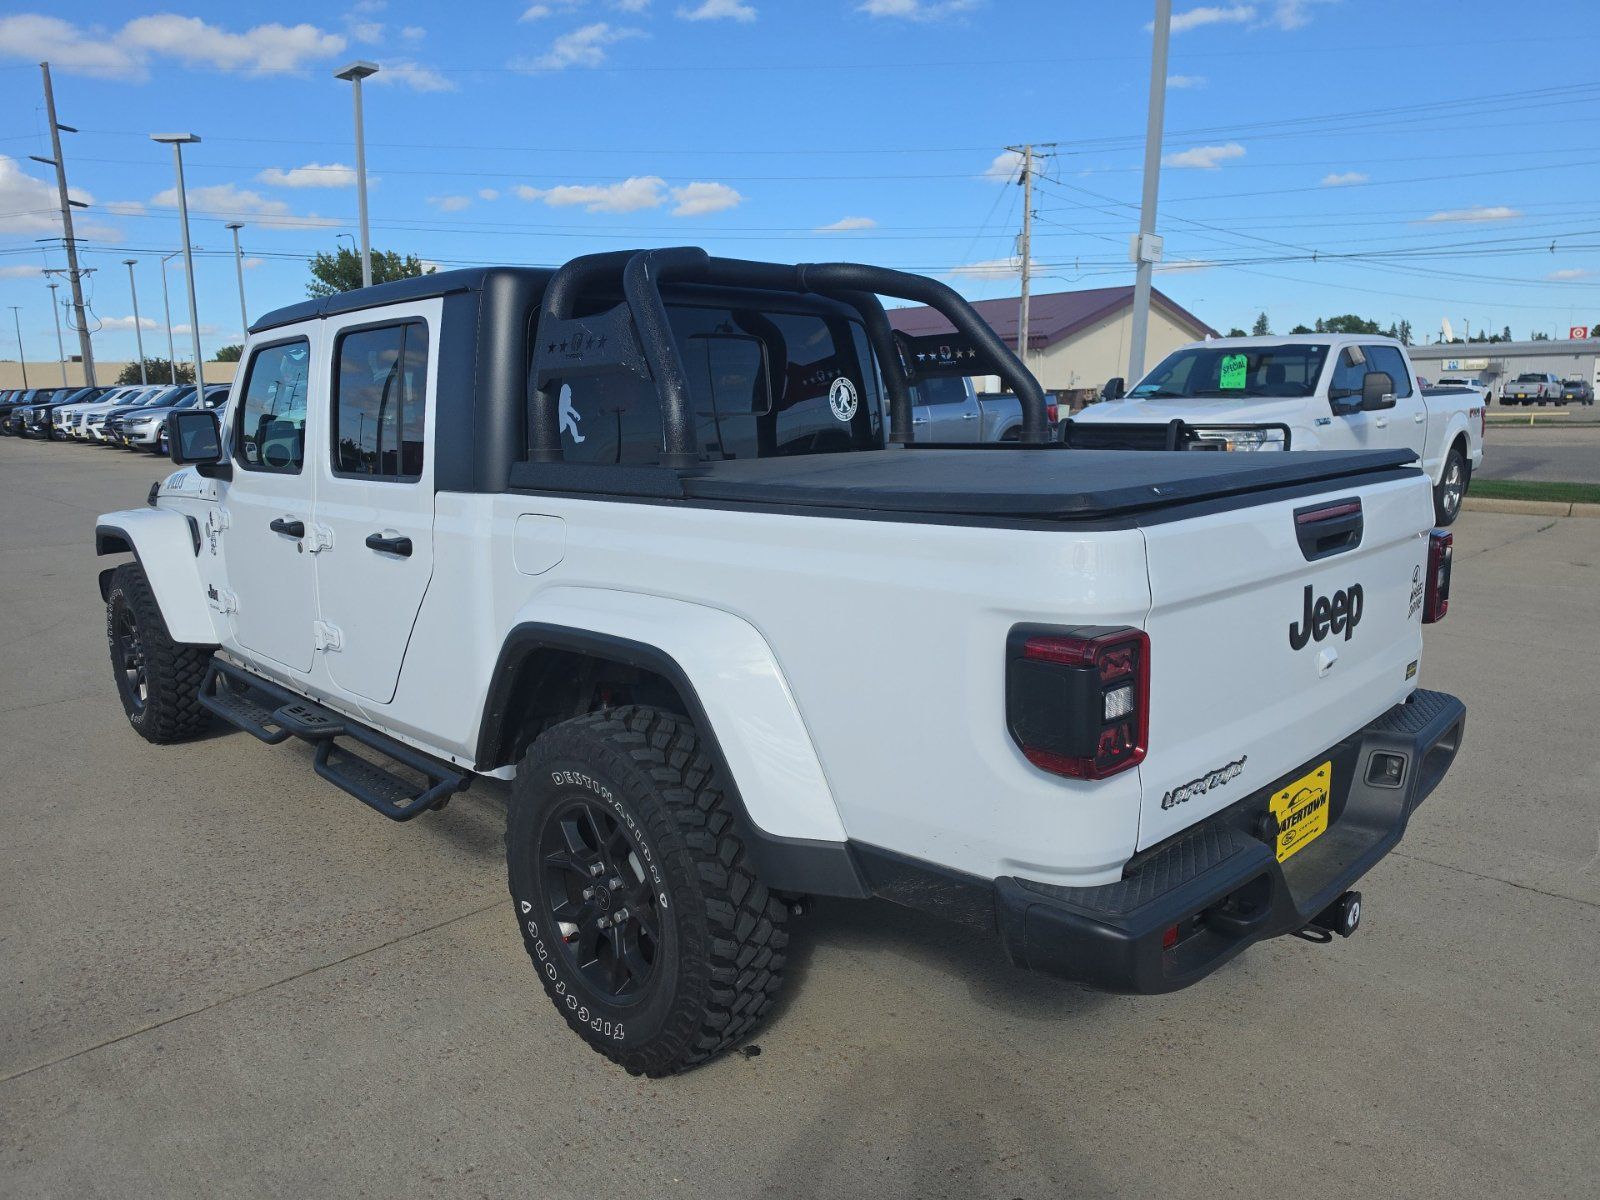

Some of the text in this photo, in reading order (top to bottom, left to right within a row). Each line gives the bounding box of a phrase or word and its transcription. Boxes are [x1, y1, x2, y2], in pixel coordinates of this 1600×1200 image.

[1222, 360, 1246, 375] SPECIAL
[1289, 582, 1364, 651] Jeep
[552, 771, 661, 884] DESTINATION
